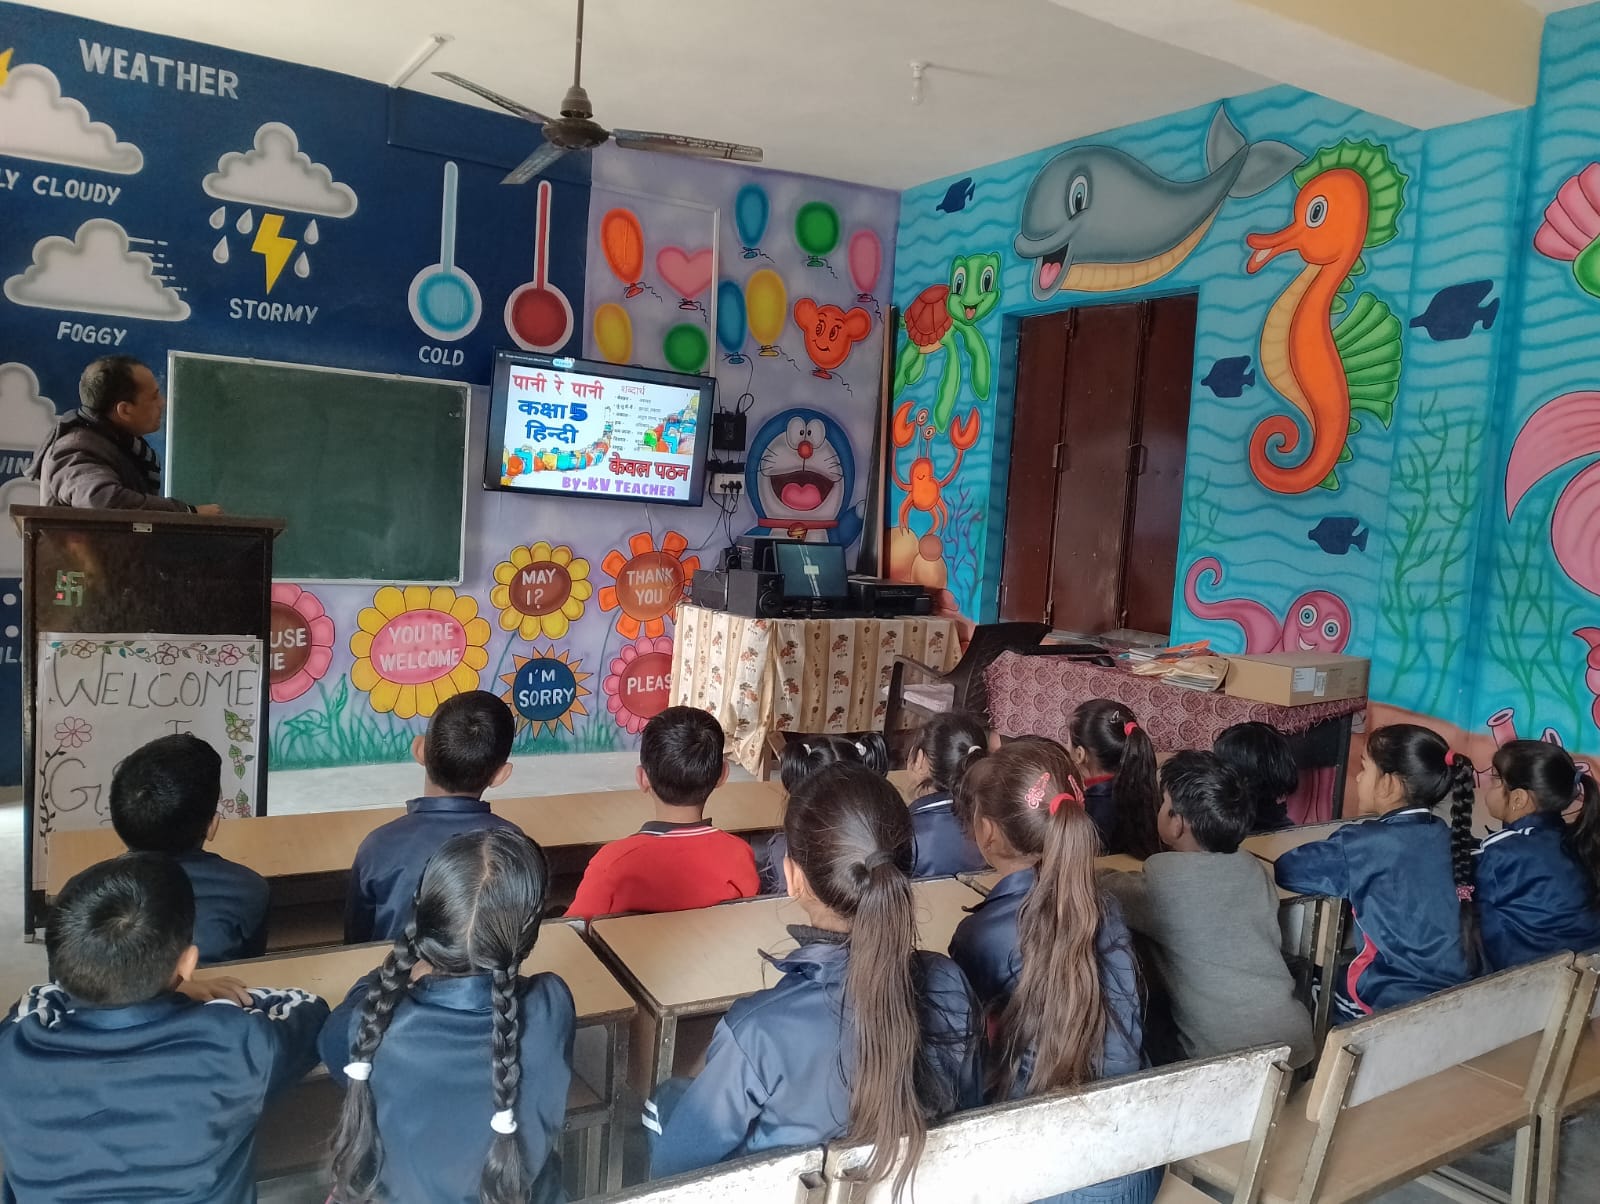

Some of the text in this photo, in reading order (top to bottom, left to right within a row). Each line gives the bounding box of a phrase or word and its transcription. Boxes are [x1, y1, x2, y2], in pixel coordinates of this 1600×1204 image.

[78, 38, 240, 101] WEATHER
[32, 175, 121, 206] CLOUDY
[229, 298, 319, 325] STORMY
[56, 320, 128, 347] FOGGY
[418, 345, 465, 367] COLD
[512, 372, 605, 400] पानी रे पानी
[525, 420, 579, 444] हिन्दी
[609, 452, 690, 481] केवल पठन
[522, 568, 557, 586] MAY
[626, 567, 675, 587] THANK
[526, 588, 545, 610] I?
[635, 588, 663, 606] YOU
[270, 627, 308, 649] USE
[388, 622, 454, 645] YOU'RE
[379, 648, 459, 672] WELCOME
[53, 651, 258, 709] WELCOME
[528, 668, 556, 685] I'M
[627, 674, 673, 695] PLEAS
[518, 687, 575, 708] SORRY
